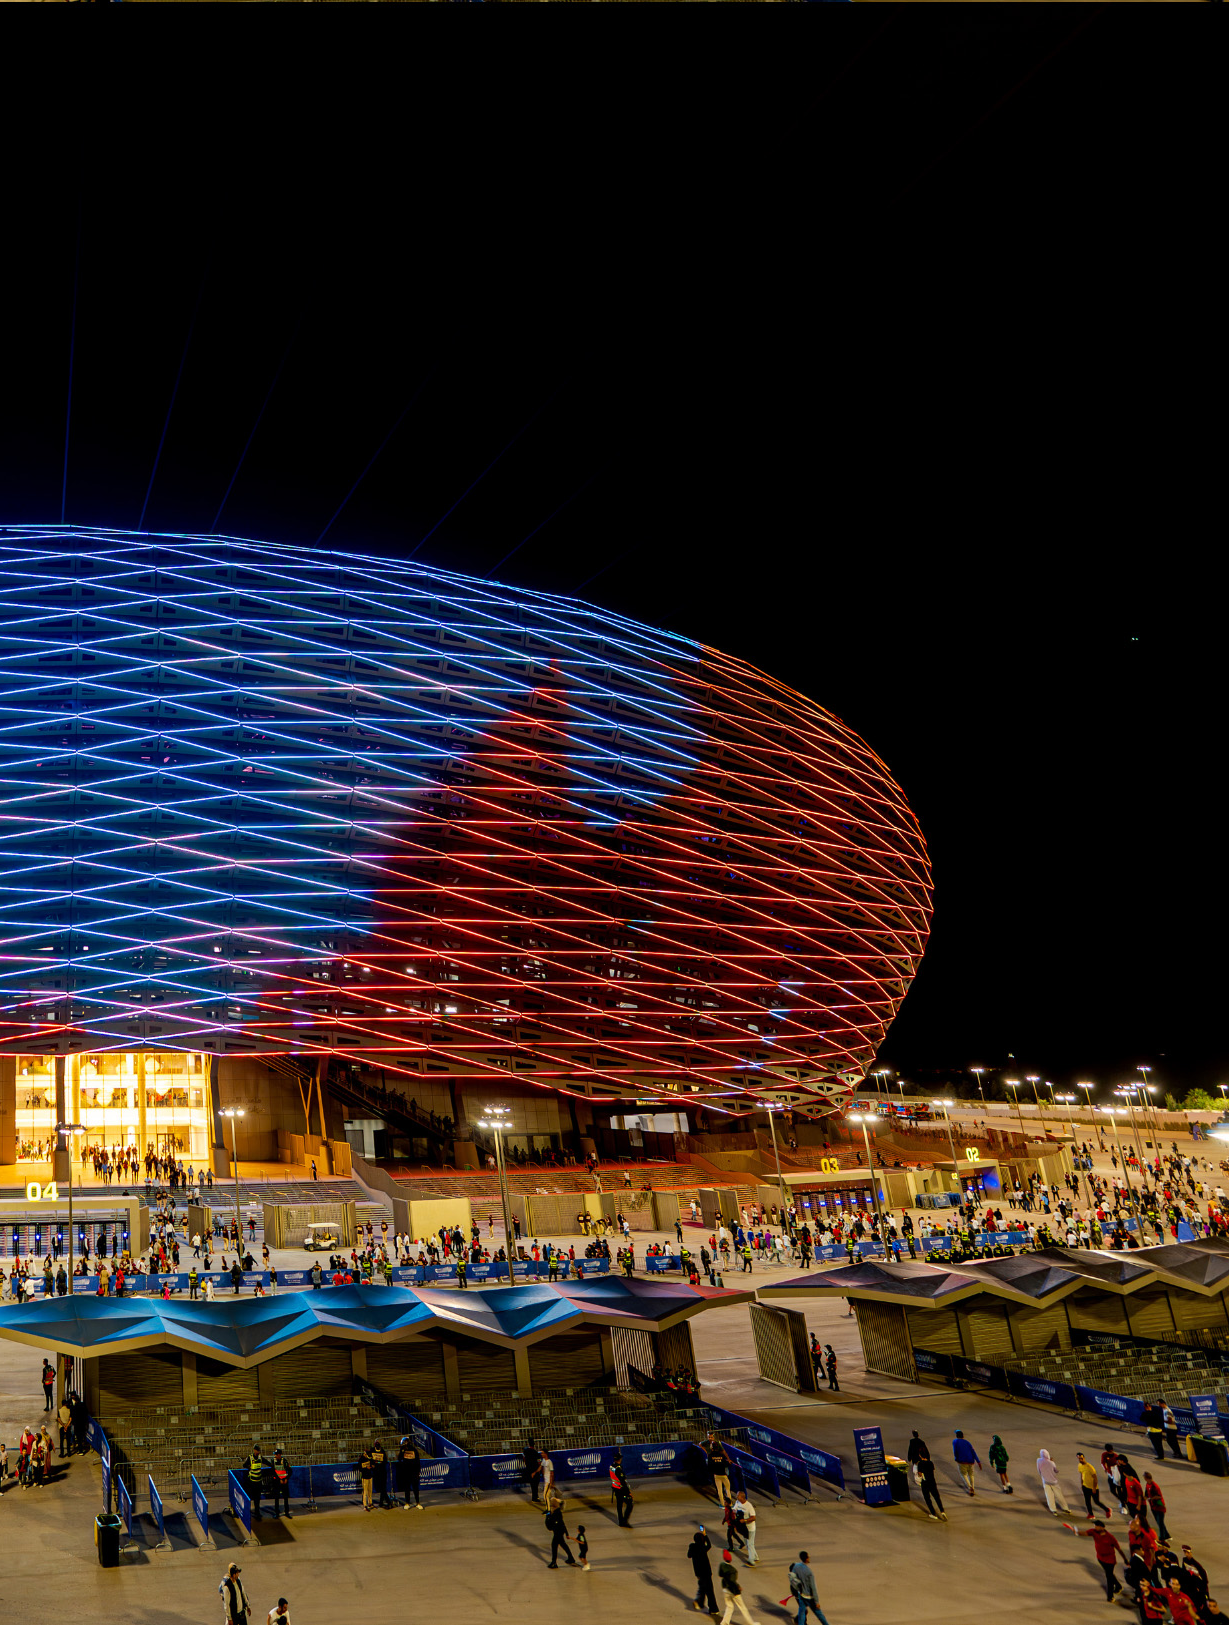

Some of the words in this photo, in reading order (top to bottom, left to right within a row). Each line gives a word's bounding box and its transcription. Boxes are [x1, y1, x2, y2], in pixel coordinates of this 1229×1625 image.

[966, 1147, 980, 1162] 02
[821, 1157, 840, 1174] 03
[26, 1181, 59, 1201] 04
